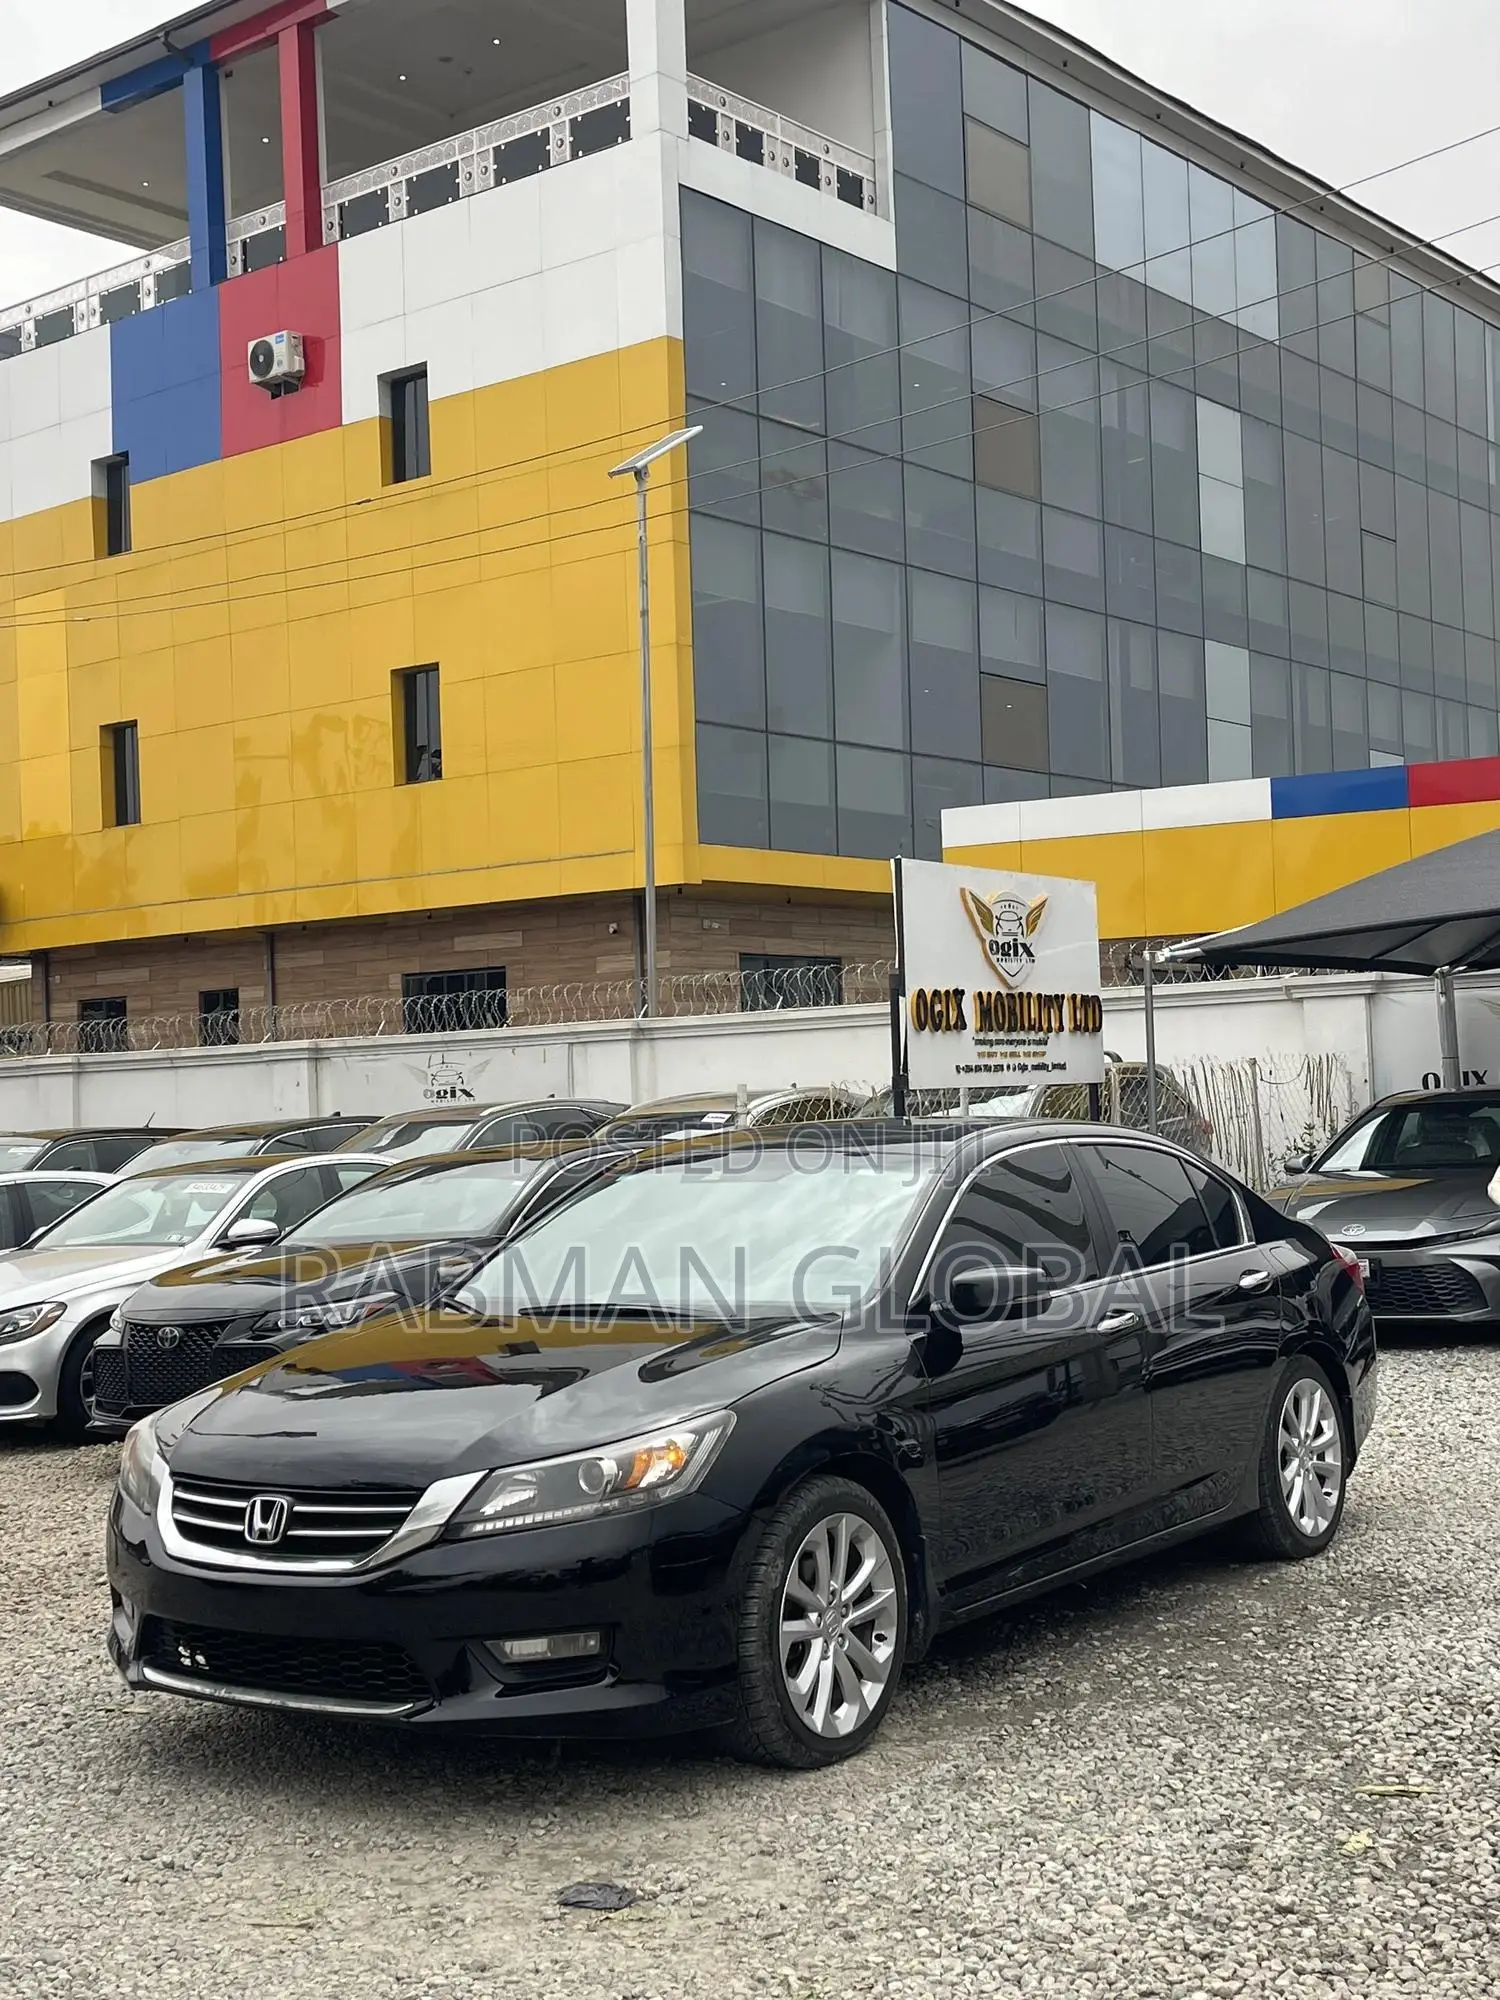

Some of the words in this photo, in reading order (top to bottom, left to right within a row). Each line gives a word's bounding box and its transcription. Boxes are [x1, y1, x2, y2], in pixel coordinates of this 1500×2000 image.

[911, 987, 967, 1032] OGIX
[973, 991, 1065, 1032] MOBILITY
[1066, 993, 1102, 1032] LTD
[1422, 1070, 1488, 1090] OIX
